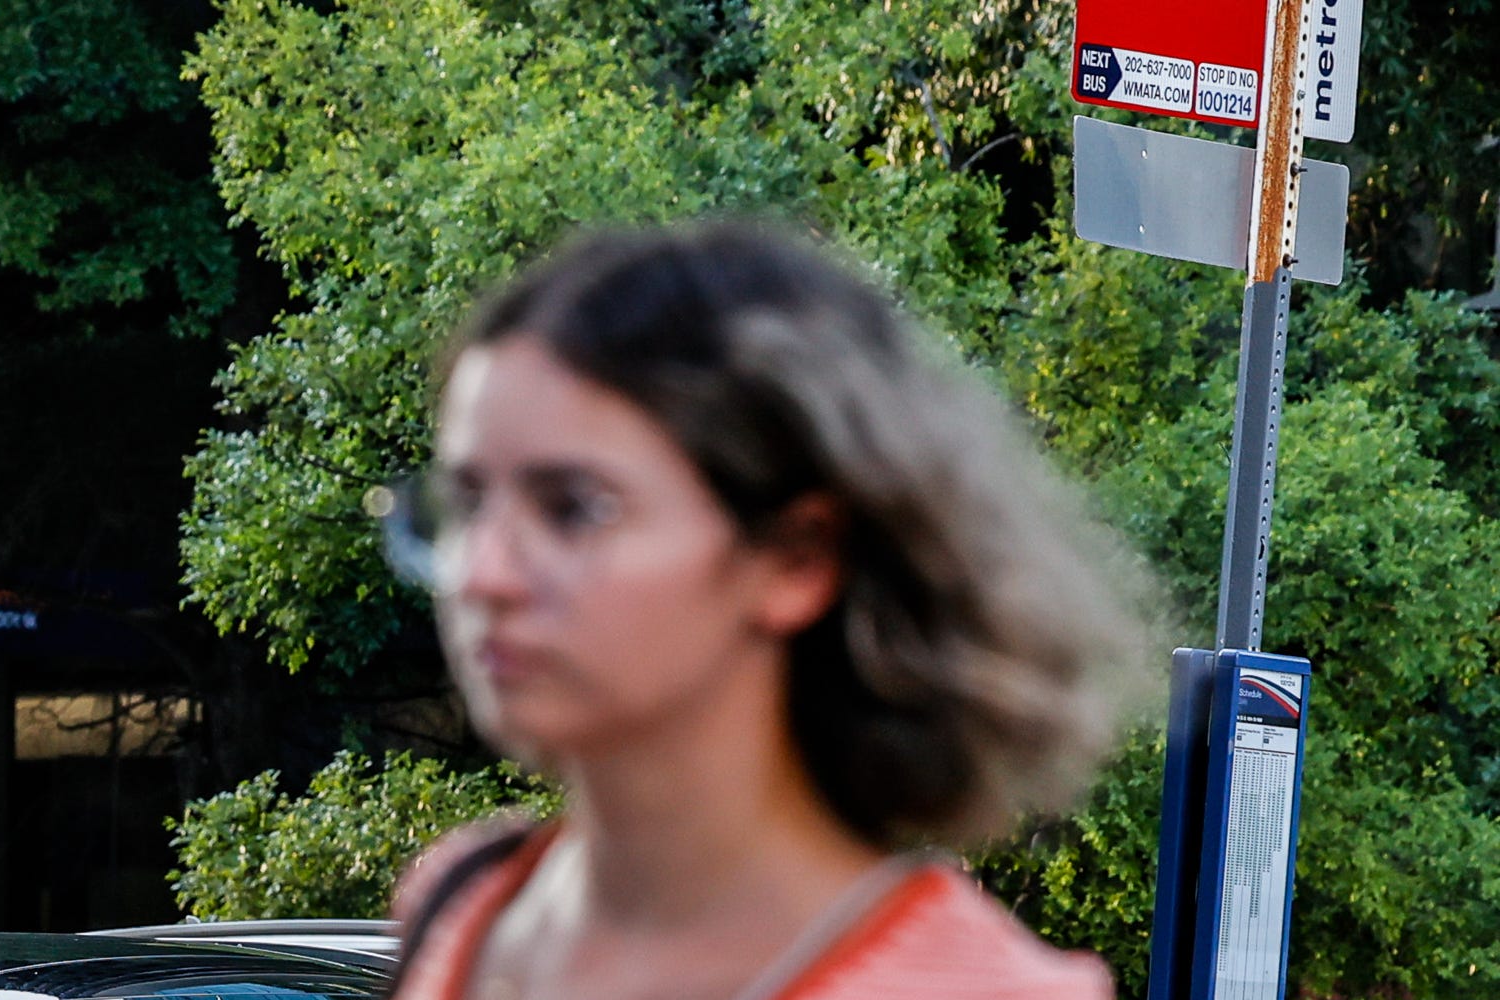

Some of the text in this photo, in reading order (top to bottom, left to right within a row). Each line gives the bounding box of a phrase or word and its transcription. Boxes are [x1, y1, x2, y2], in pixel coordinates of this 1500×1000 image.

[1081, 49, 1111, 69] NEXT
[1125, 56, 1192, 81] 202-637-7000
[1083, 74, 1107, 92] BUS
[1199, 67, 1256, 88] STOP ID NO.
[1124, 80, 1190, 104] WMATA.COM
[1198, 90, 1252, 116] 1001214
